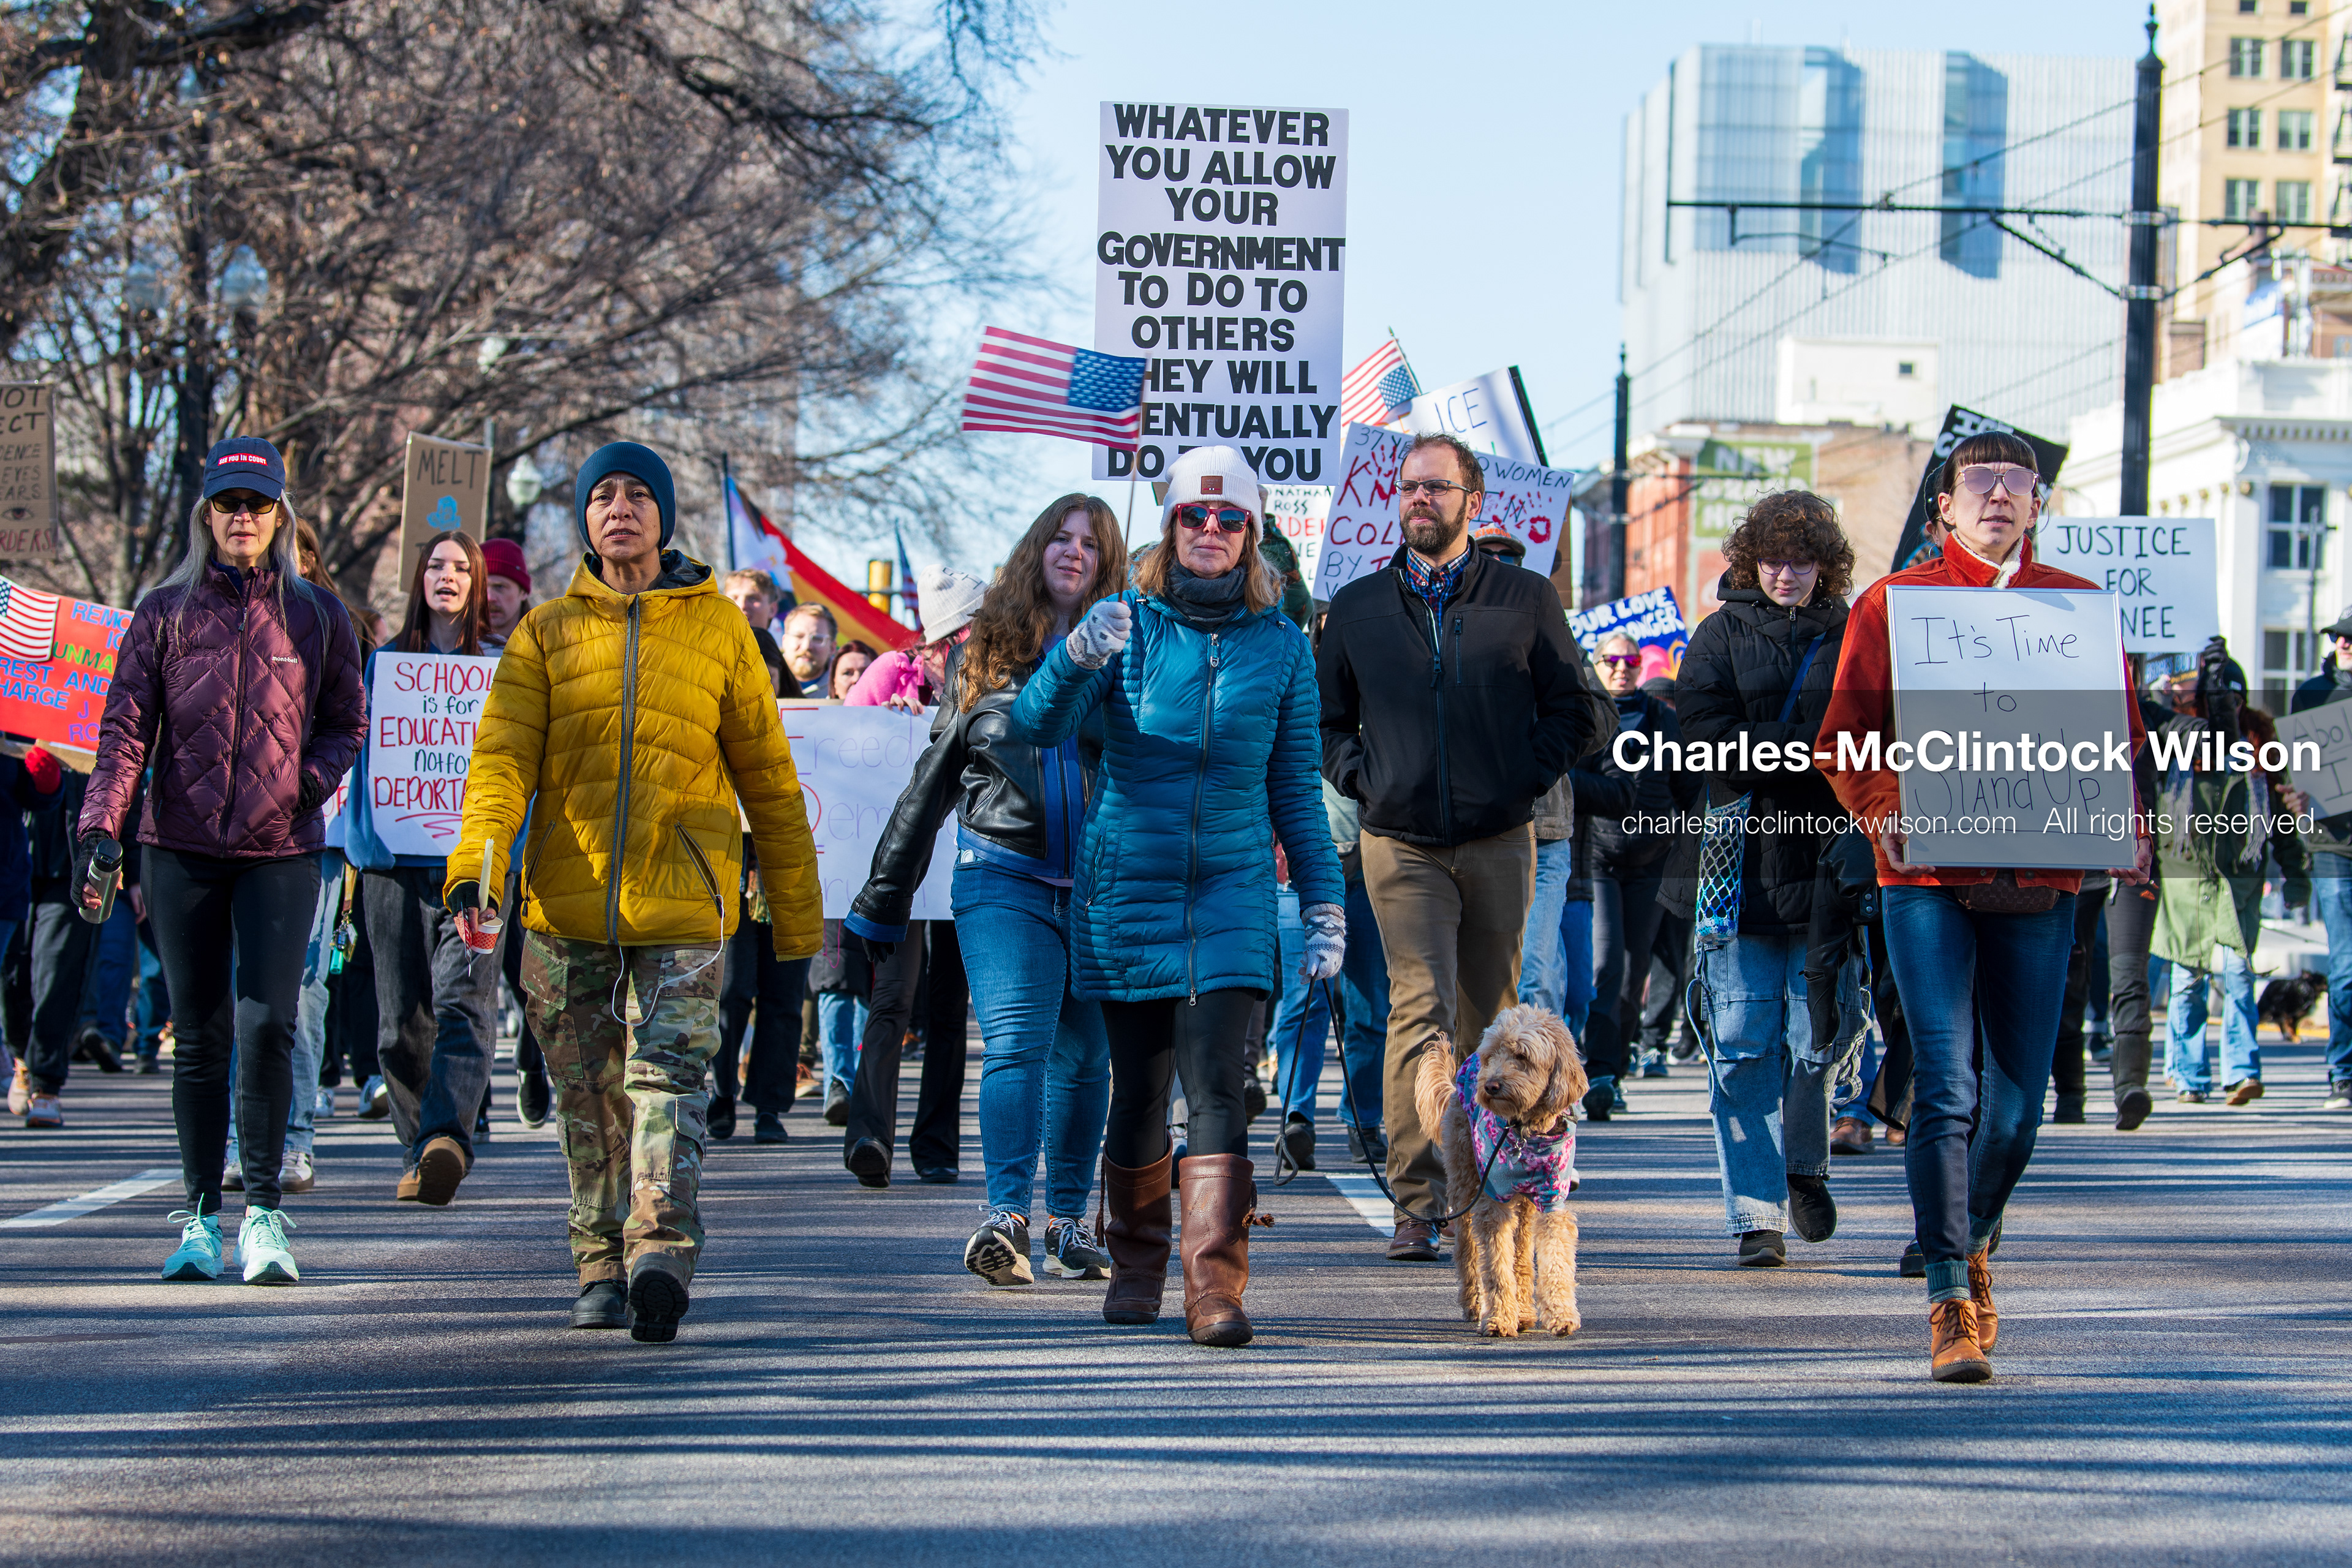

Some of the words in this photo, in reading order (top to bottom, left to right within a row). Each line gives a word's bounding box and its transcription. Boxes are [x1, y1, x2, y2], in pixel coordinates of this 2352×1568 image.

[1113, 103, 1329, 146] WHATEVER
[1105, 145, 1190, 182] YOU
[1200, 151, 1336, 189] ALLOW
[1164, 187, 1278, 226] YOUR
[1097, 231, 1346, 271] GOVERNMENT
[1118, 271, 1169, 308] TO
[1187, 272, 1245, 307] DO
[1254, 277, 1308, 313] TO
[1131, 315, 1295, 352] OTHERS
[1145, 358, 1213, 393] HEY
[1227, 360, 1317, 394] WILL
[0, 386, 46, 409] OT
[1434, 388, 1488, 433] ICE
[1142, 402, 1338, 439] ENTUALLY
[1355, 427, 1384, 450] 37
[248, 455, 266, 464] COURT
[417, 448, 484, 489] MELT
[1107, 445, 1165, 478] DO
[1240, 446, 1322, 481] YOU
[1495, 462, 1571, 488] WOMEN
[0, 528, 56, 552] RDERS!
[1330, 516, 1403, 545] COL
[2057, 525, 2191, 559] JUSTICE
[1324, 551, 1362, 580] BY
[2106, 568, 2157, 596] FOR
[1568, 604, 1618, 639] OUR
[1615, 587, 1674, 619] LOVE
[1910, 617, 1992, 665] It's
[0, 679, 70, 710] HARGE
[64, 671, 111, 696] AND
[1973, 682, 2017, 712] to
[423, 695, 437, 714] is
[444, 696, 479, 714] for
[445, 752, 470, 774] fo
